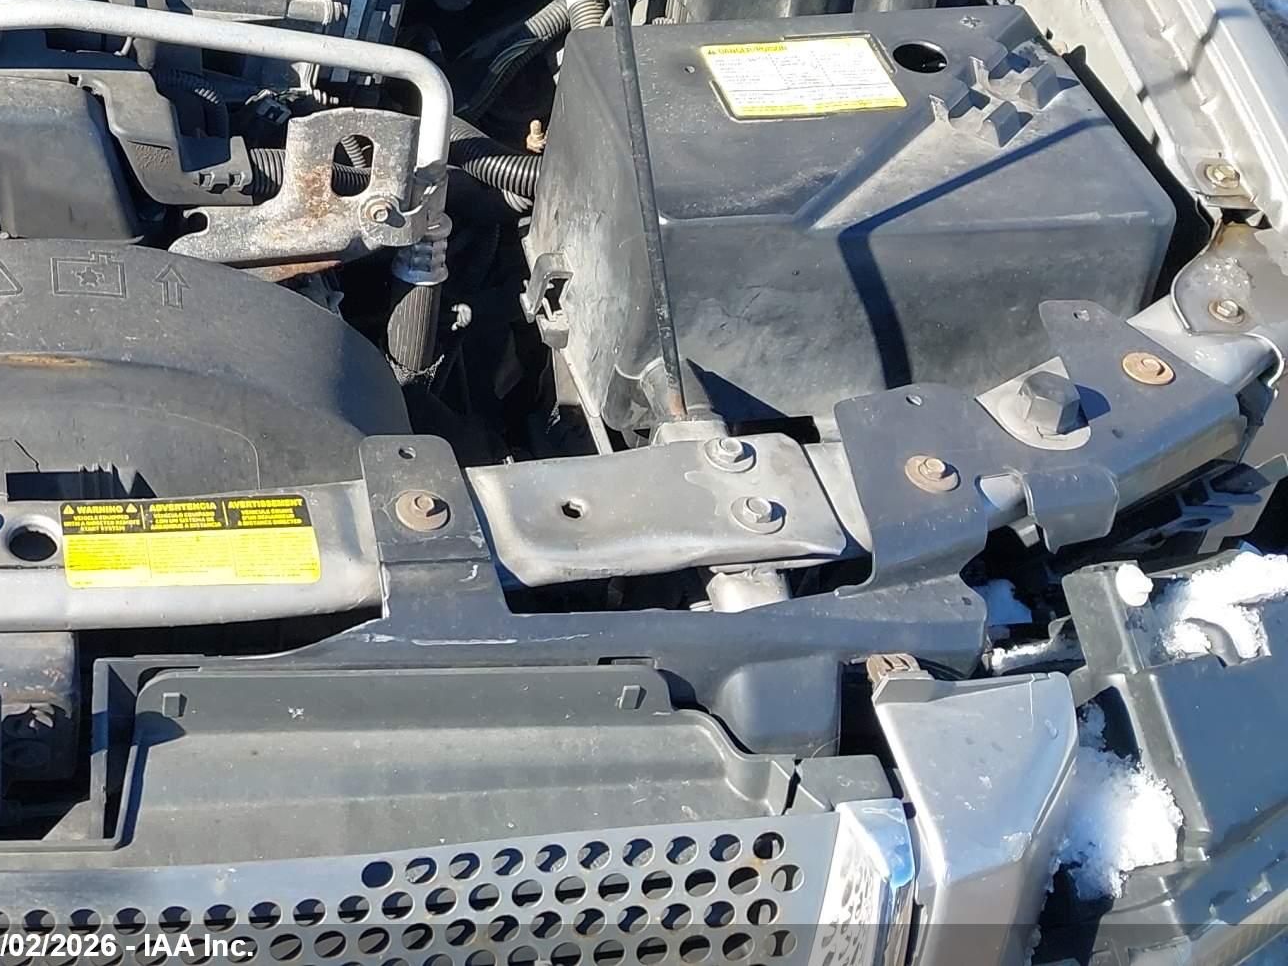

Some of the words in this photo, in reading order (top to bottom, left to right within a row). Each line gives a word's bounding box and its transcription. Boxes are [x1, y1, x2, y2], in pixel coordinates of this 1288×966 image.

[149, 502, 217, 512] ADVERTENCIA
[228, 498, 303, 509] AVERTISSEMENT
[76, 505, 124, 514] WARNING
